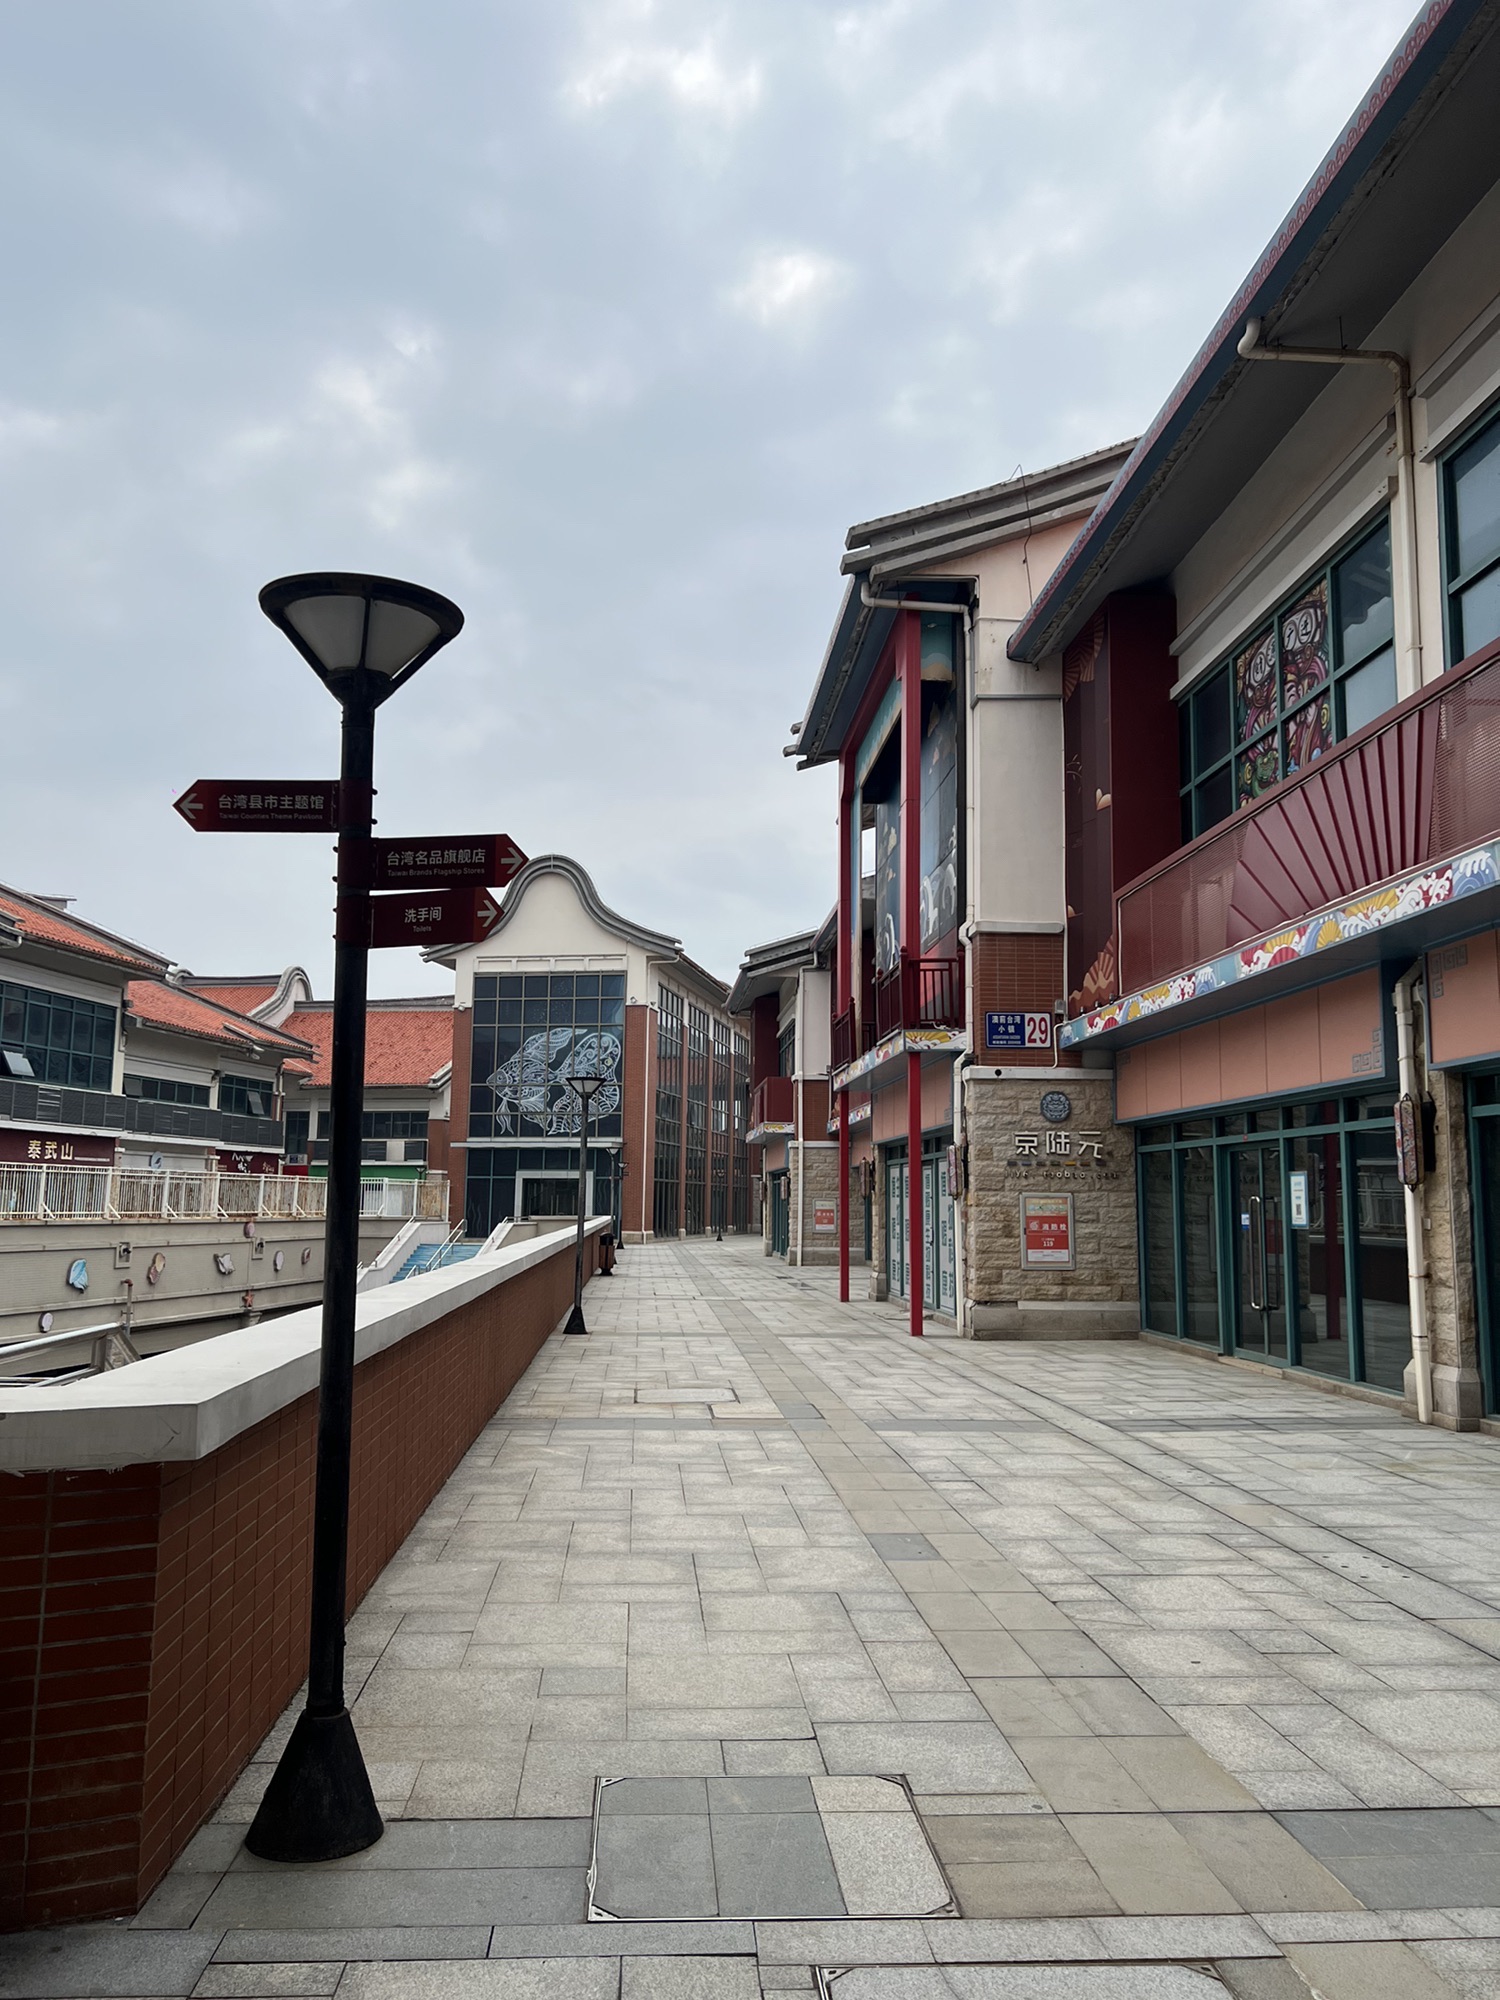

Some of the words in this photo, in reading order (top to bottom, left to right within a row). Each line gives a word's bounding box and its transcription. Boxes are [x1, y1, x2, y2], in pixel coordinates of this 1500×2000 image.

[218, 794, 324, 809] 台湾县市主题馆
[387, 849, 486, 866] 台湾名品旗舰店
[409, 868, 432, 876] Brands
[433, 868, 462, 877] Flagship
[463, 867, 485, 875] Stores
[404, 907, 442, 923] 洗手间
[1027, 1016, 1049, 1044] 29
[28, 1140, 74, 1160] 泰武山
[1014, 1130, 1104, 1159] 京陆元
